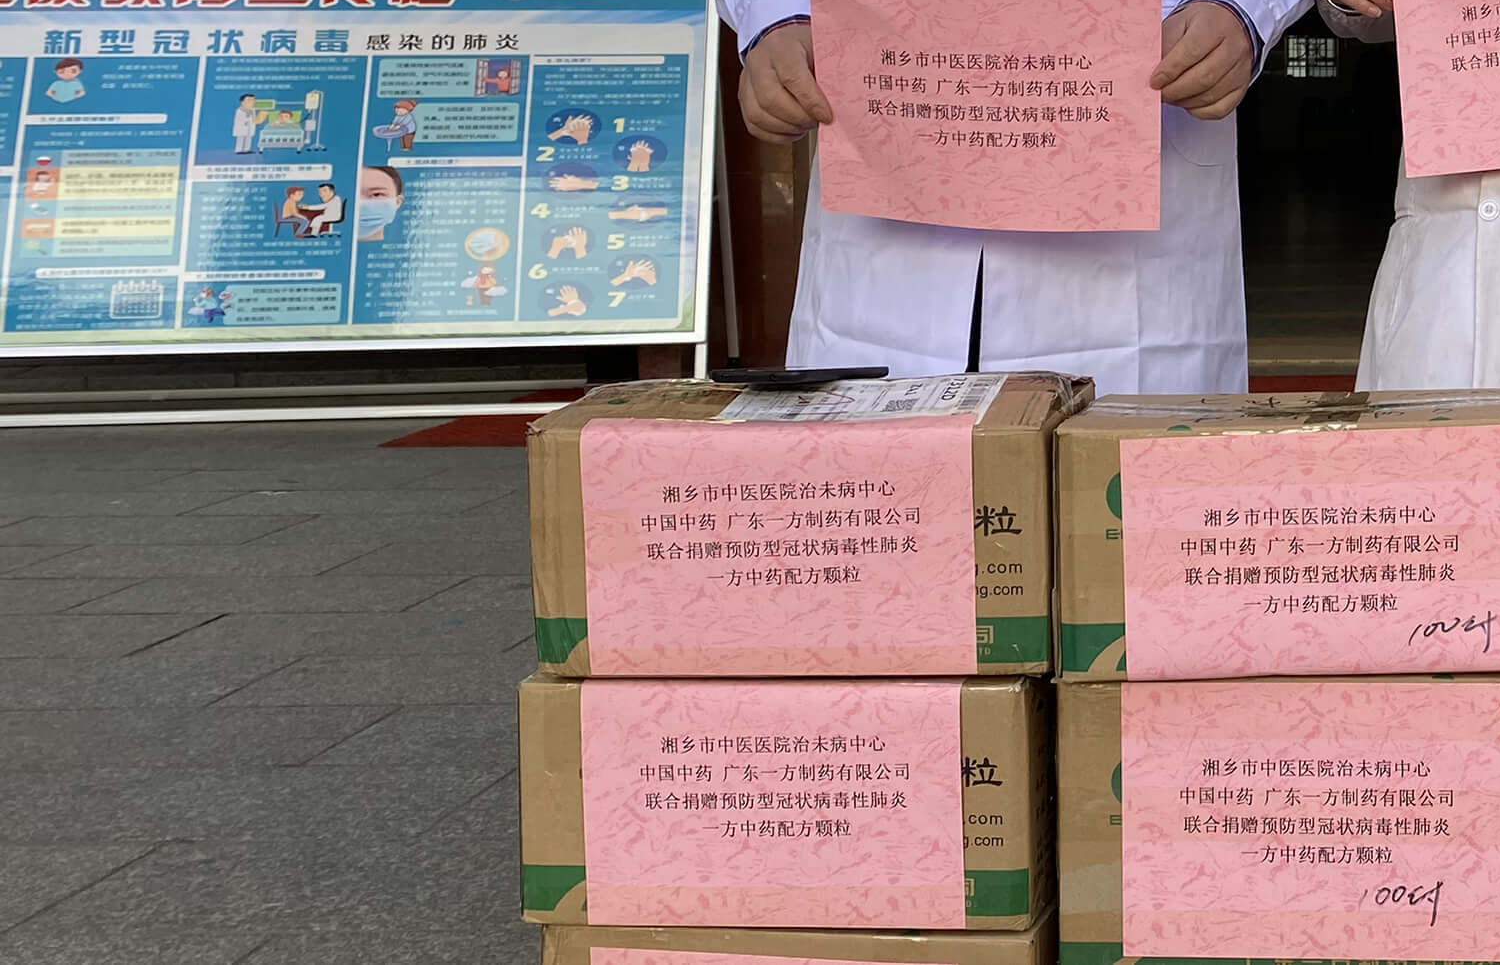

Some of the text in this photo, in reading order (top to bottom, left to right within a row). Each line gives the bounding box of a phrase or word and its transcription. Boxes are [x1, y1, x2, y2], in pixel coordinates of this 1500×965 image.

[43, 29, 520, 54] 新型冠状病毒 感染的肺炎
[880, 48, 1093, 73] 湘乡市中医医院治未病中心
[863, 73, 1114, 98] 中国中药 广东一方制药有限公司
[867, 98, 1111, 124] 联合捐赠预防型冠状病毒性肺炎
[613, 118, 626, 134] 1
[918, 130, 1057, 149] 一方中药配方颗粒
[535, 146, 556, 162] 2
[610, 175, 630, 191] 3
[530, 202, 551, 219] 4
[607, 234, 626, 250] 5
[528, 263, 549, 280] 6
[608, 291, 627, 308] 7
[662, 479, 896, 503] 湘乡市中医医院治未病中心
[640, 505, 922, 534] 中国中药 广东一方制药有限公司
[975, 505, 1023, 537] 粒
[1203, 506, 1436, 528] 湘乡市中医医院治未病中心
[646, 536, 919, 562] 联合捐赠预防型冠状病毒性肺炎
[1180, 534, 1460, 557] 中国中药 广东一方制药有限公司
[706, 565, 862, 588] 一方中药配方颗粒
[1184, 563, 1456, 585] 联合捐赠预防型冠状病毒性肺炎
[1242, 593, 1399, 615] 一方中药配方颗粒
[660, 734, 887, 756] 湘乡市中医医院治未病中心
[639, 762, 911, 784] 中国中药 广东一方制药有限公司
[961, 756, 1003, 787] 粒
[1201, 758, 1432, 779] 湘乡市中医医院治未病中心
[645, 791, 908, 812] 联合捐赠预防型冠状病毒性肺炎
[1178, 787, 1455, 808] 中国中药 广东一方制药有限公司
[702, 819, 853, 839] 一方中药配方颗粒
[1183, 815, 1451, 837] 联合捐赠预防型冠状病毒性肺炎
[1240, 844, 1393, 866] 一方中药配方颗粒
